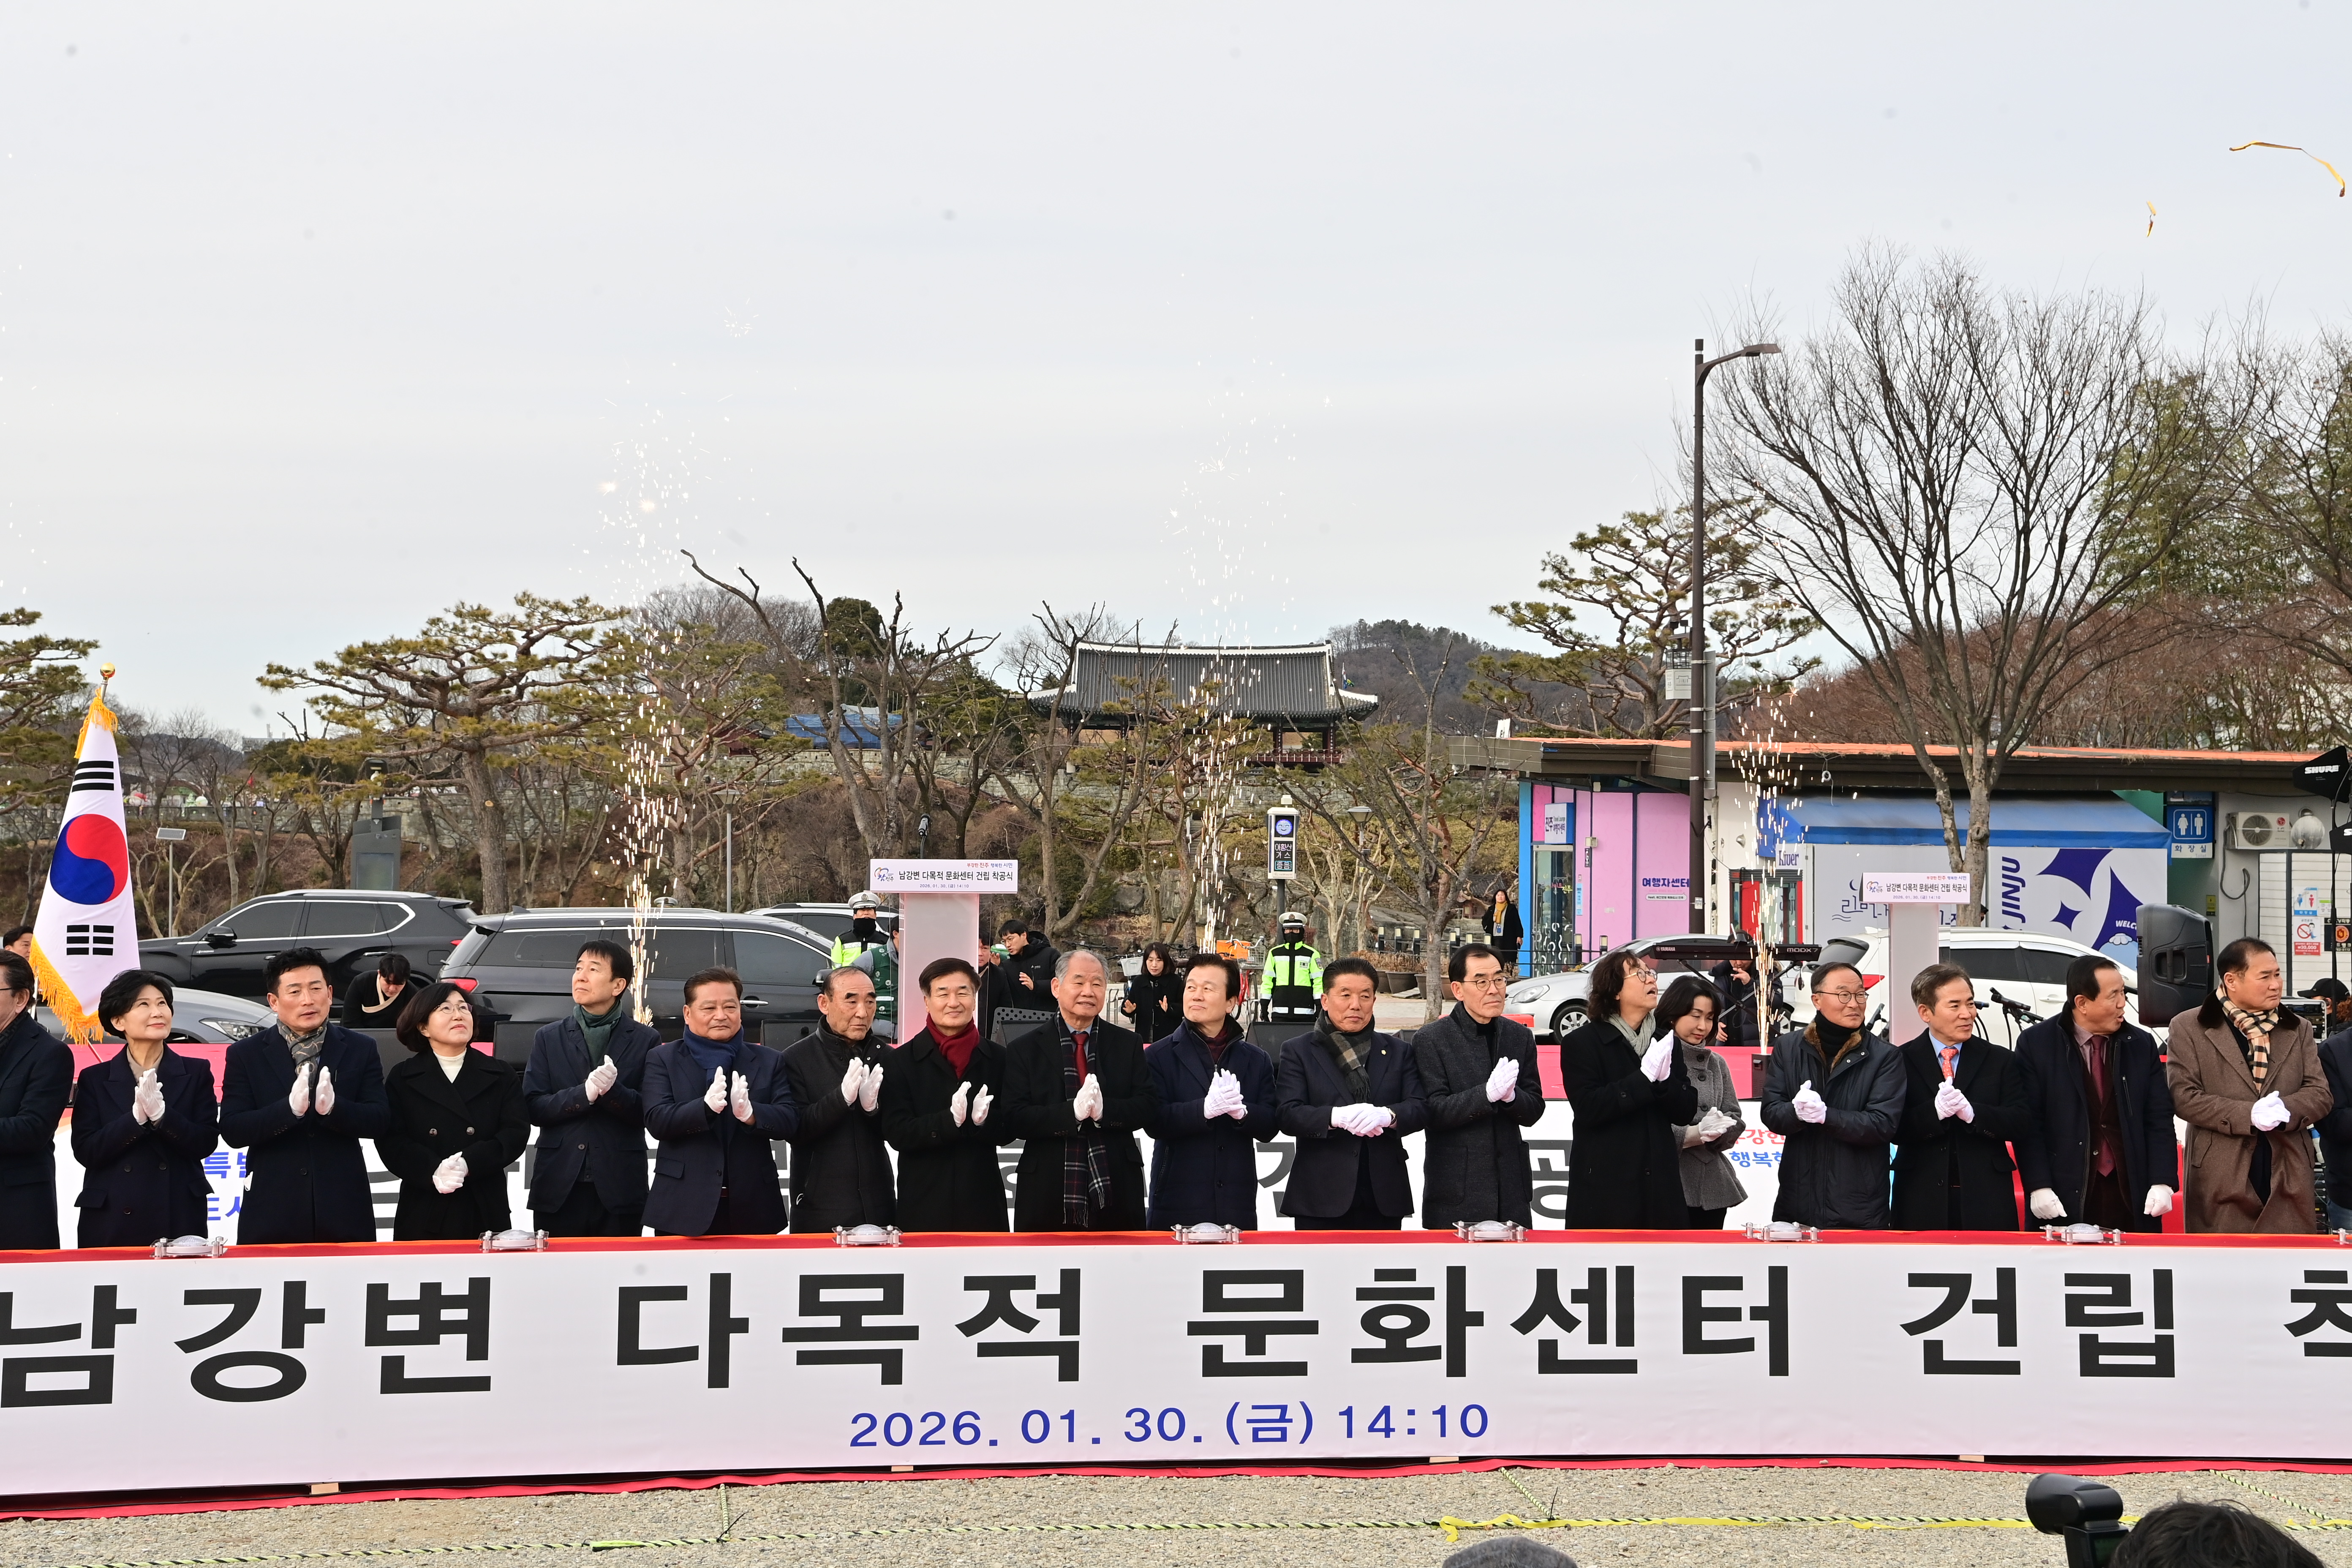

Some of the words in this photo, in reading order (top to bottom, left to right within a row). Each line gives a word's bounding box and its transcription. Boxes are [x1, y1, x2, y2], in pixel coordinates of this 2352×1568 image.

[2304, 765, 2339, 774] SHURE
[1545, 817, 1553, 832] 진주
[2175, 845, 2206, 853] 화장실
[1276, 861, 1290, 869] 좋음
[899, 871, 920, 881] 남강변
[922, 871, 943, 881] 다목적
[945, 871, 974, 881] 문화센터
[976, 871, 990, 881] 건립
[992, 871, 1013, 881] 착공식
[1642, 877, 1690, 887] 여행자센터
[1886, 883, 1901, 892] 남강변
[1903, 883, 1918, 892] 다목적
[1919, 883, 1939, 892] 문화센터
[1941, 883, 1951, 892] 건립
[1952, 883, 1967, 892] 착공식
[2002, 856, 2026, 923] JINJU
[2115, 920, 2137, 930] WELC
[0, 1277, 491, 1408] 남강변
[617, 1268, 1081, 1388] 다목적
[1187, 1266, 1789, 1377] 문화센터
[1900, 1267, 2175, 1378] 건립
[850, 1410, 998, 1447] 2026.
[1021, 1409, 1101, 1444] 01.
[1124, 1407, 1203, 1443] 30.
[1226, 1401, 1313, 1445] (금)
[1338, 1404, 1488, 1438] 14:10
